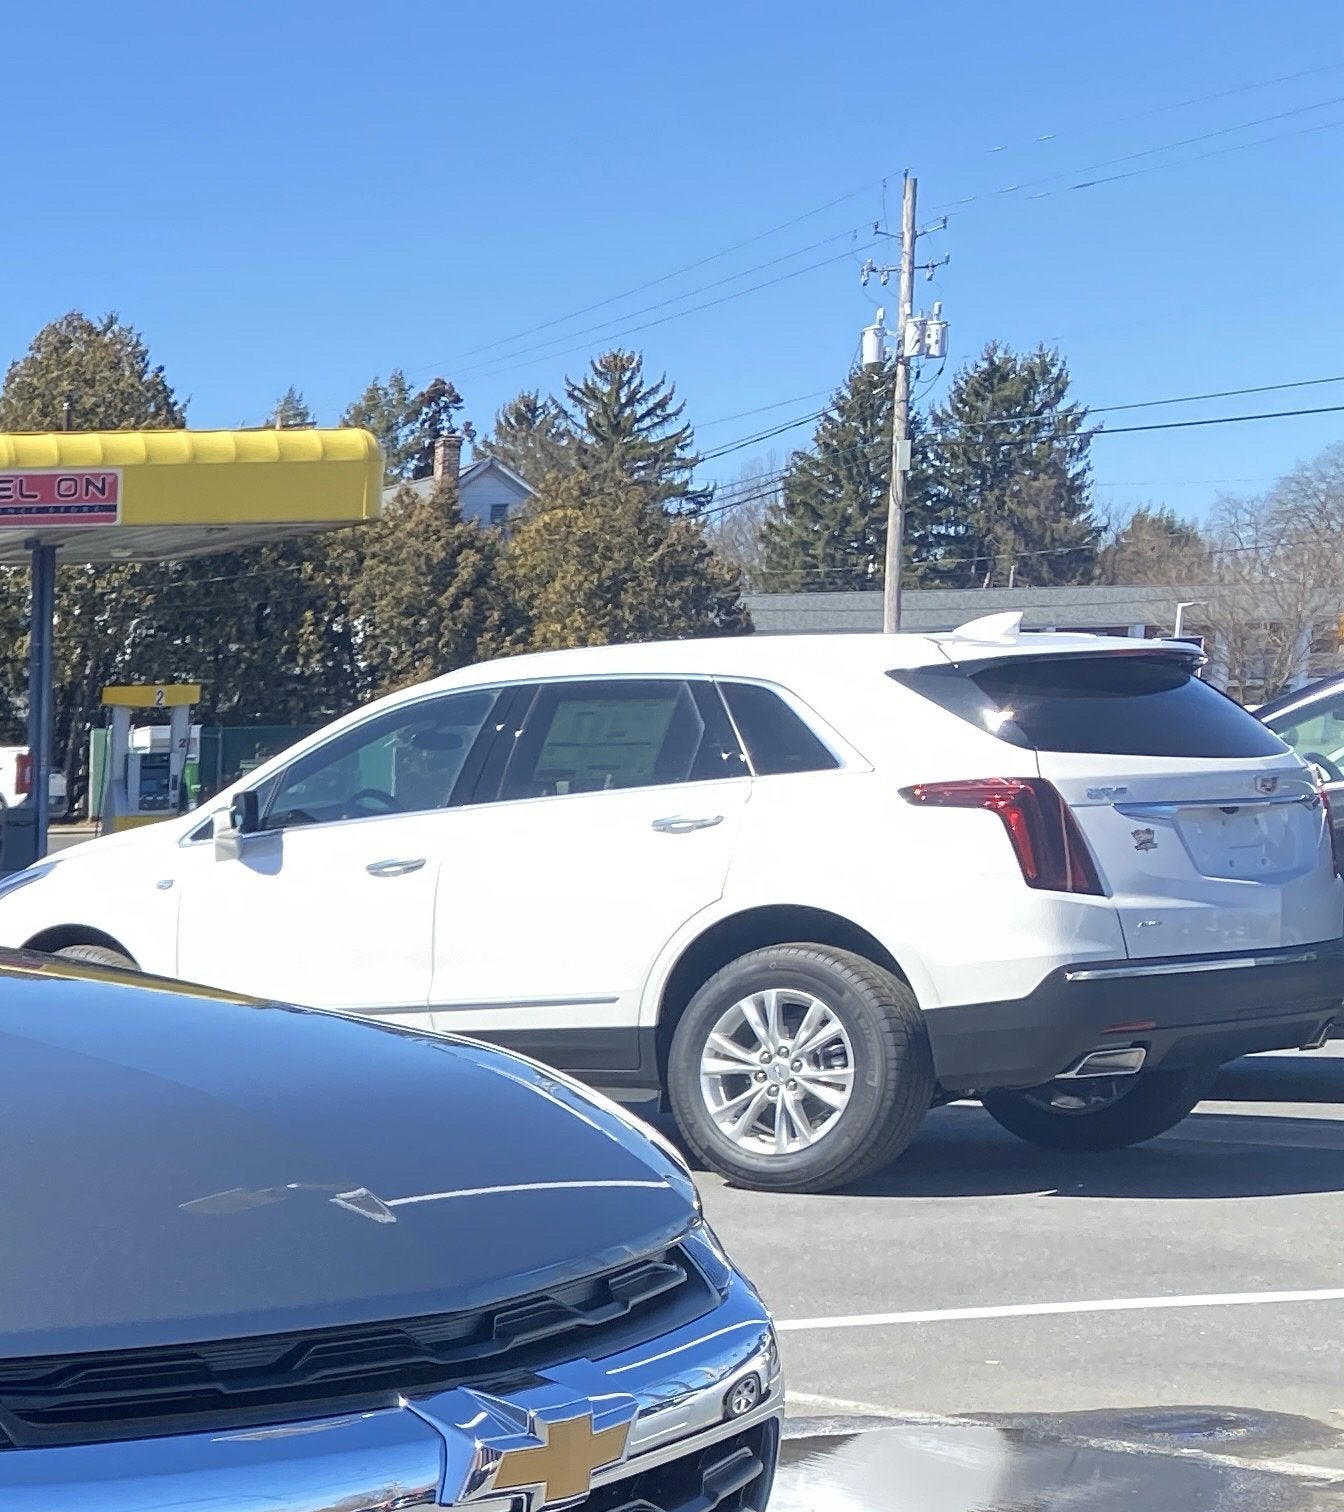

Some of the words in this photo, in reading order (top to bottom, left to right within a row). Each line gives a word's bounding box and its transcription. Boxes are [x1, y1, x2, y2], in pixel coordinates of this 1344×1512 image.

[55, 476, 108, 500] ON
[155, 689, 165, 705] 2
[178, 738, 187, 748] 2
